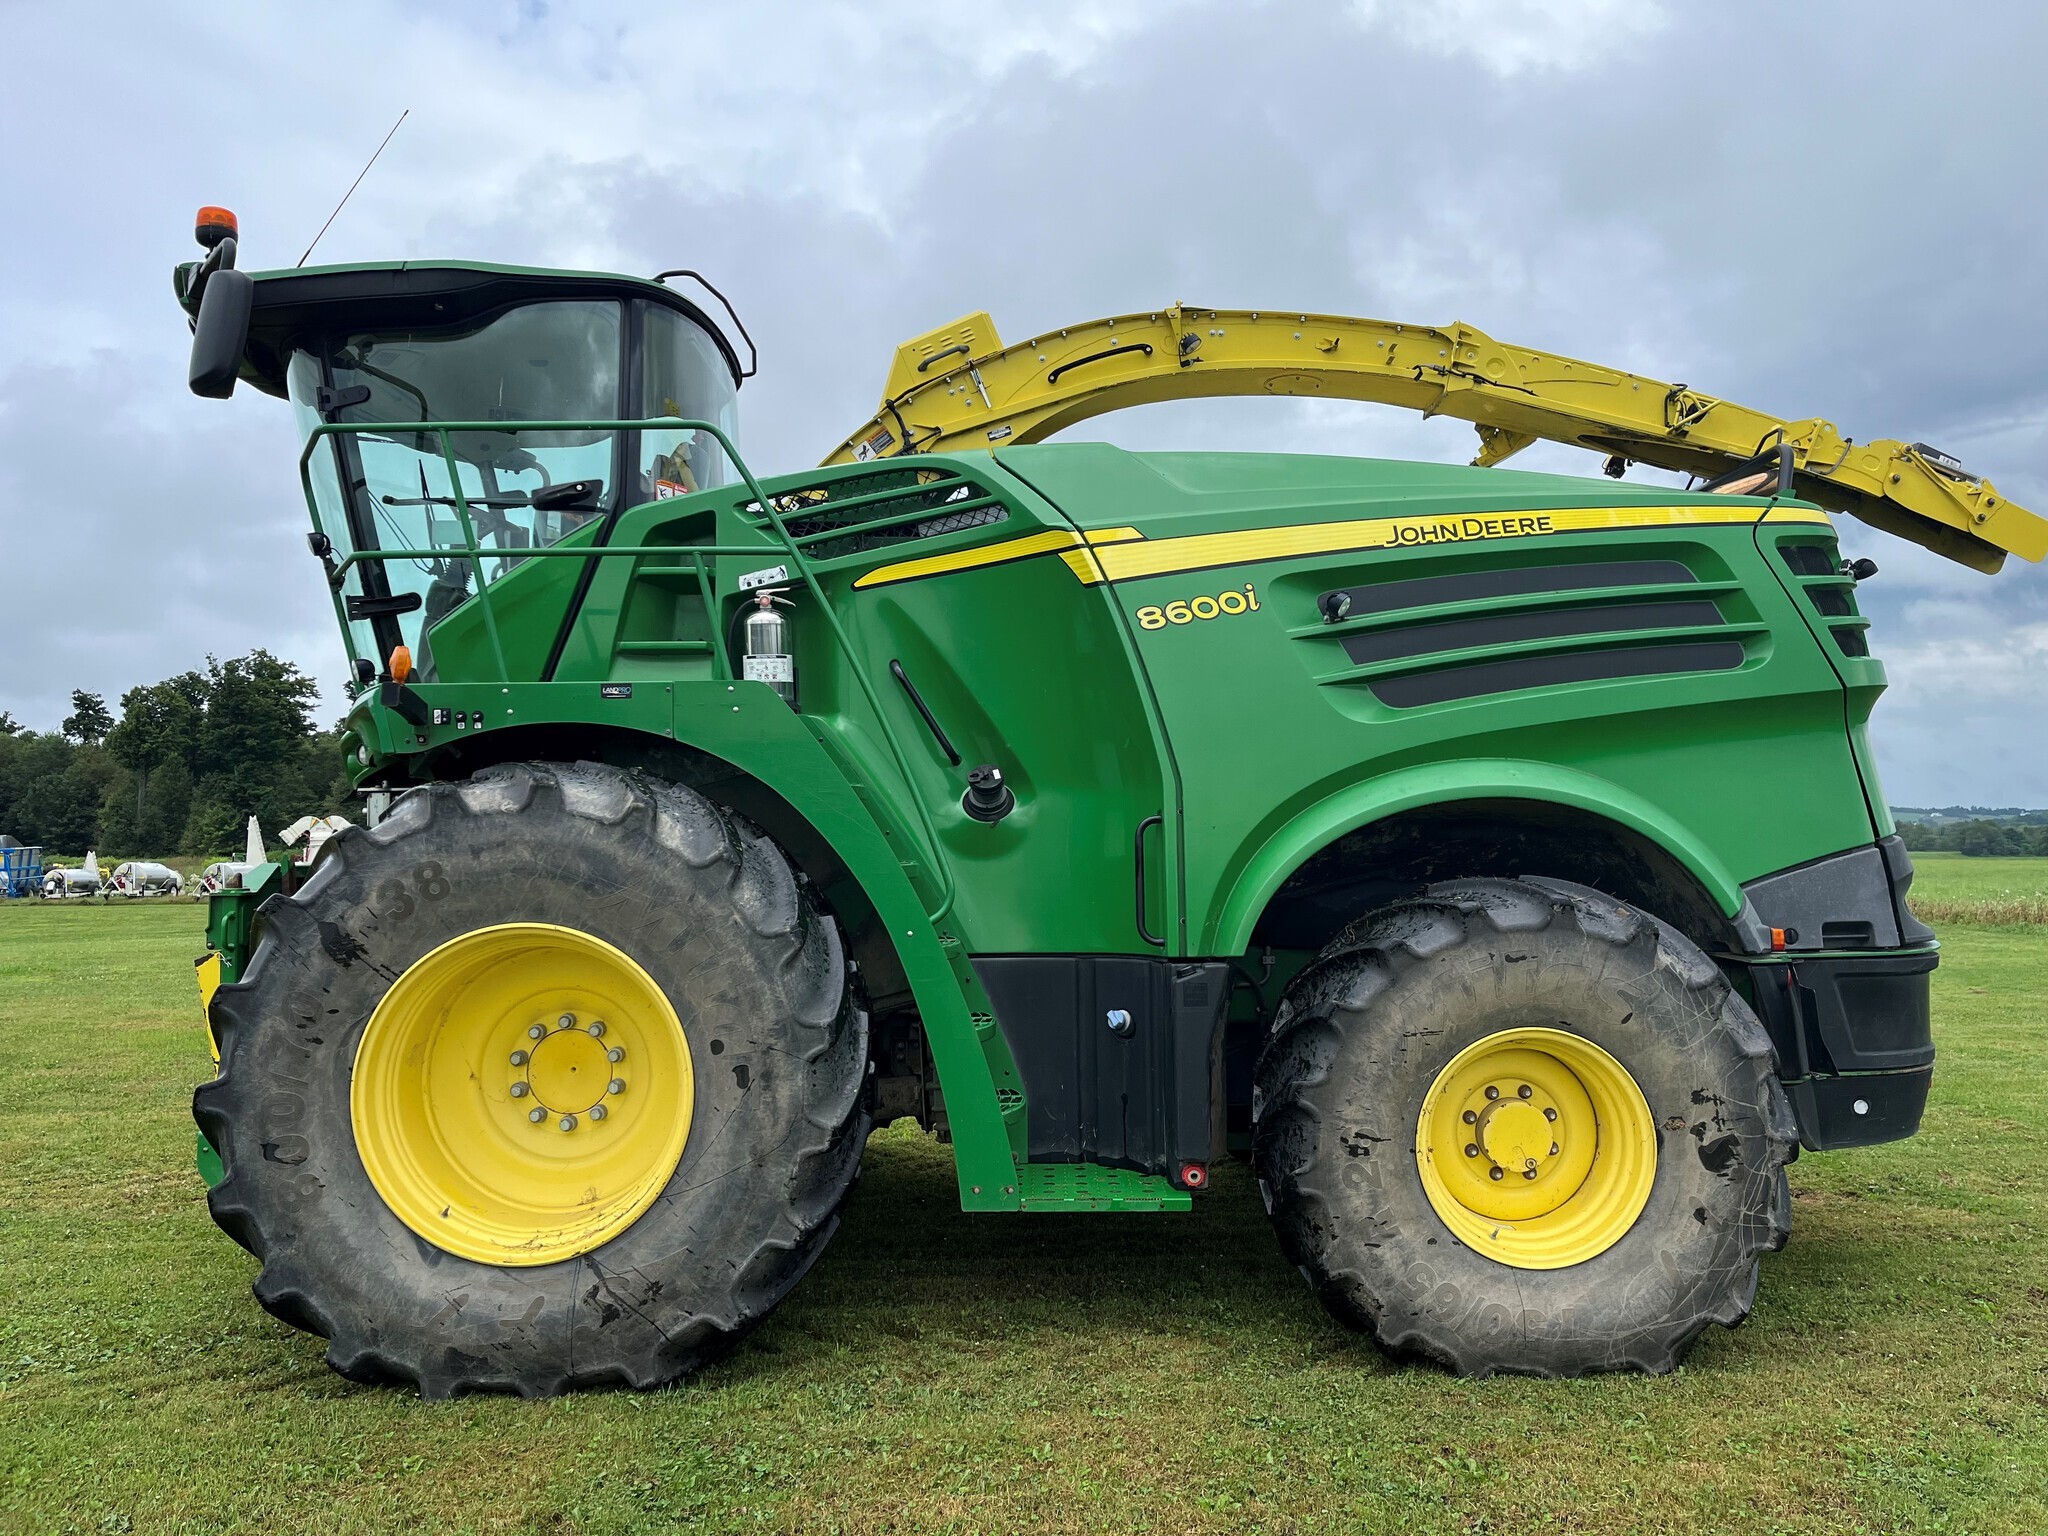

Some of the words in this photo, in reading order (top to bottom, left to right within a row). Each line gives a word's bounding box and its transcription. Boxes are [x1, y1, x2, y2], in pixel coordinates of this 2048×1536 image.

[1385, 523, 1460, 545] JOHN
[1461, 516, 1554, 538] DEERE
[1136, 583, 1261, 630] 8600i
[376, 860, 451, 922] 38
